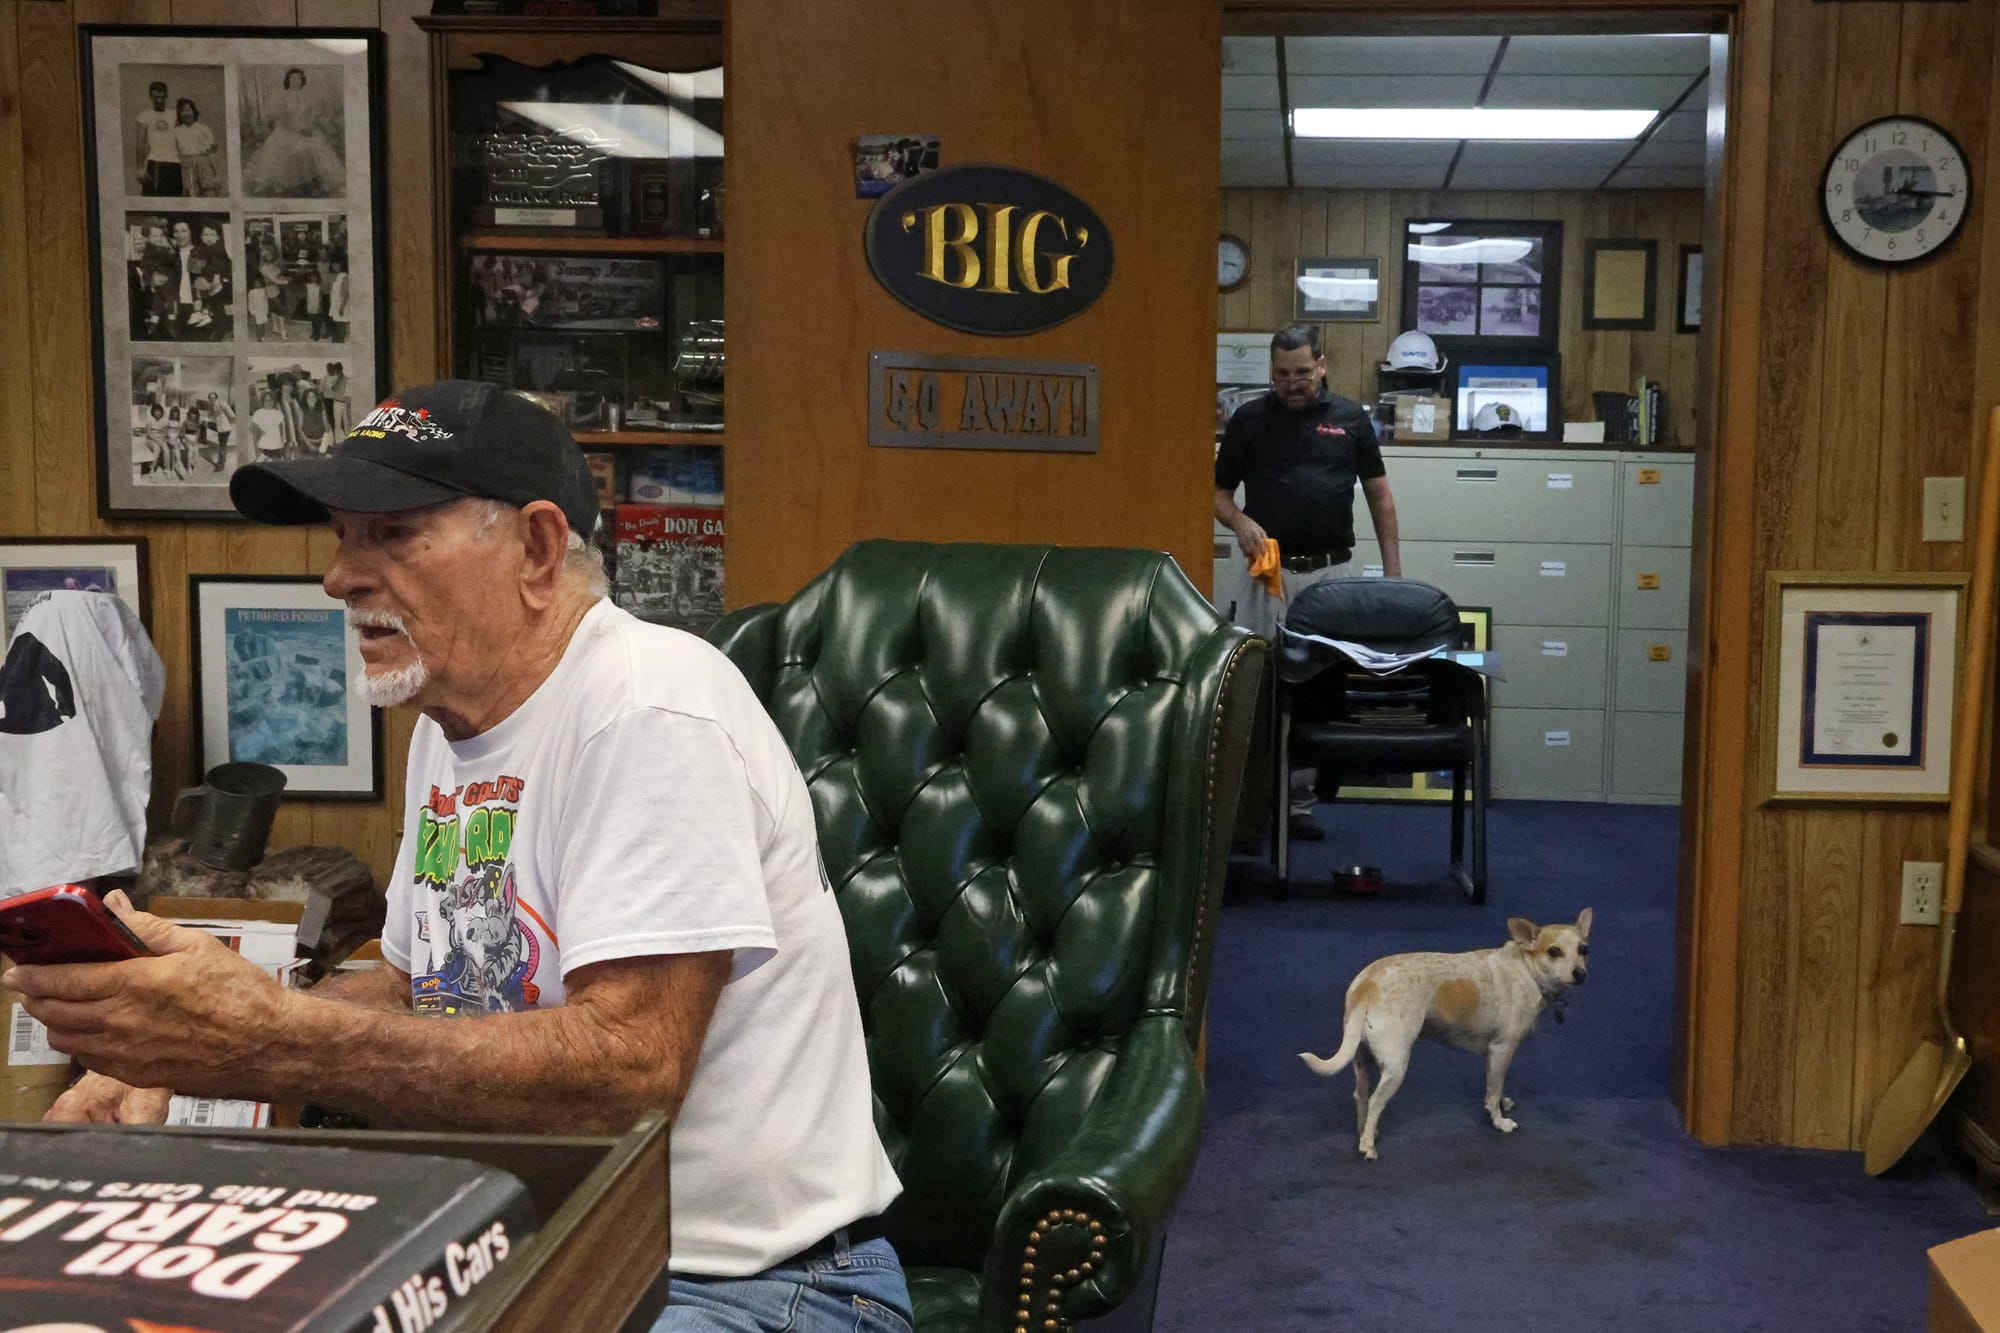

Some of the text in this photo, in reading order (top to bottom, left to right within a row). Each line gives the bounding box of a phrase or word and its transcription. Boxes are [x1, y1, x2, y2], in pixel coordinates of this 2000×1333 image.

[1864, 138, 1877, 152] 11
[1892, 132, 1906, 145] 12
[1922, 138, 1927, 151] 1
[1844, 158, 1860, 172] 10
[1938, 156, 1949, 170] 2
[1834, 184, 1843, 196] 9
[1841, 209, 1851, 223] 8
[1937, 210, 1946, 222] 4
[1863, 227, 1873, 241] 7
[1915, 229, 1925, 243] 5
[1887, 238, 1896, 250] 6
[555, 260, 601, 279] Swamp
[886, 374, 1086, 437] GO AWAY!
[664, 516, 699, 536] DON
[238, 611, 329, 622] PETRIFIED FOREST
[96, 1181, 203, 1202] Cars
[208, 1184, 288, 1207] His
[282, 1188, 378, 1211] and
[62, 1241, 303, 1300] Don
[391, 1273, 448, 1333] His
[445, 1221, 510, 1297] Cars
